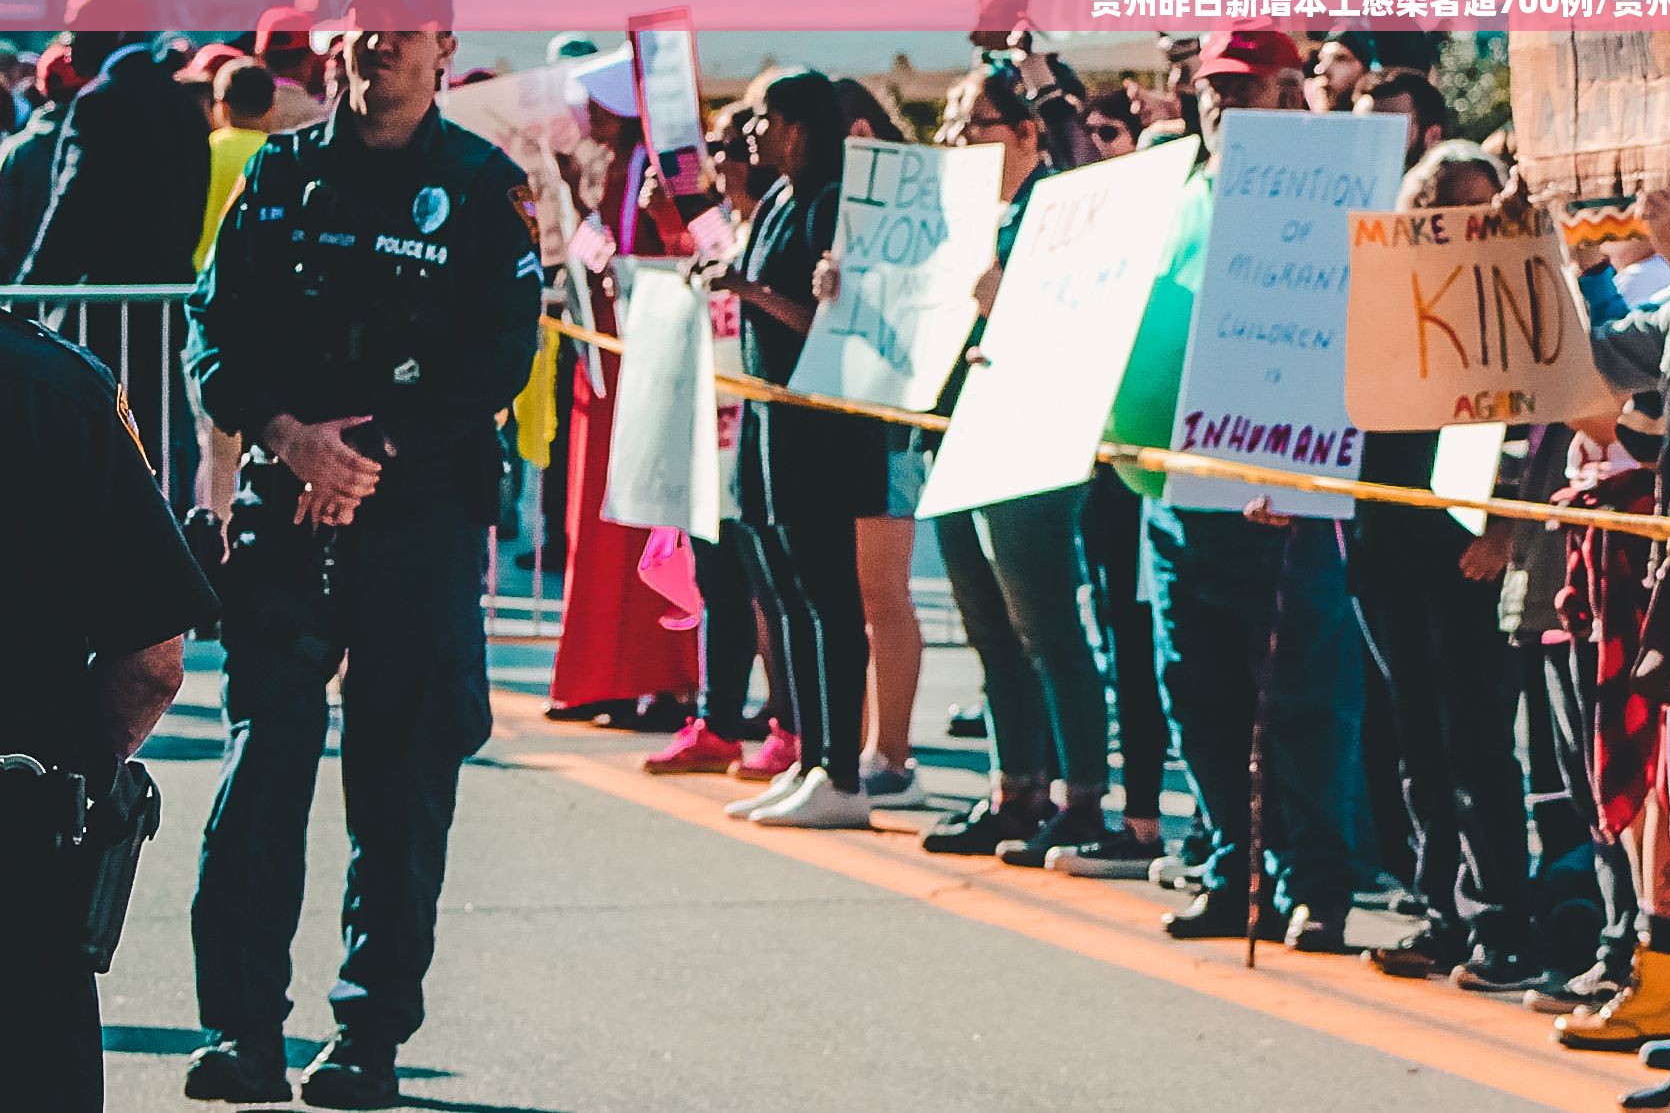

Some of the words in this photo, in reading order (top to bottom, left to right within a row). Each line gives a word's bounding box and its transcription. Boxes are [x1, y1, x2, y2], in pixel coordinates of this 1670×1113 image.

[1222, 142, 1377, 207] DETENTION
[374, 235, 424, 259] POLICE
[1355, 213, 1450, 248] MAKE
[1411, 256, 1565, 379] KIND
[1184, 410, 1359, 467] INHUMANE
